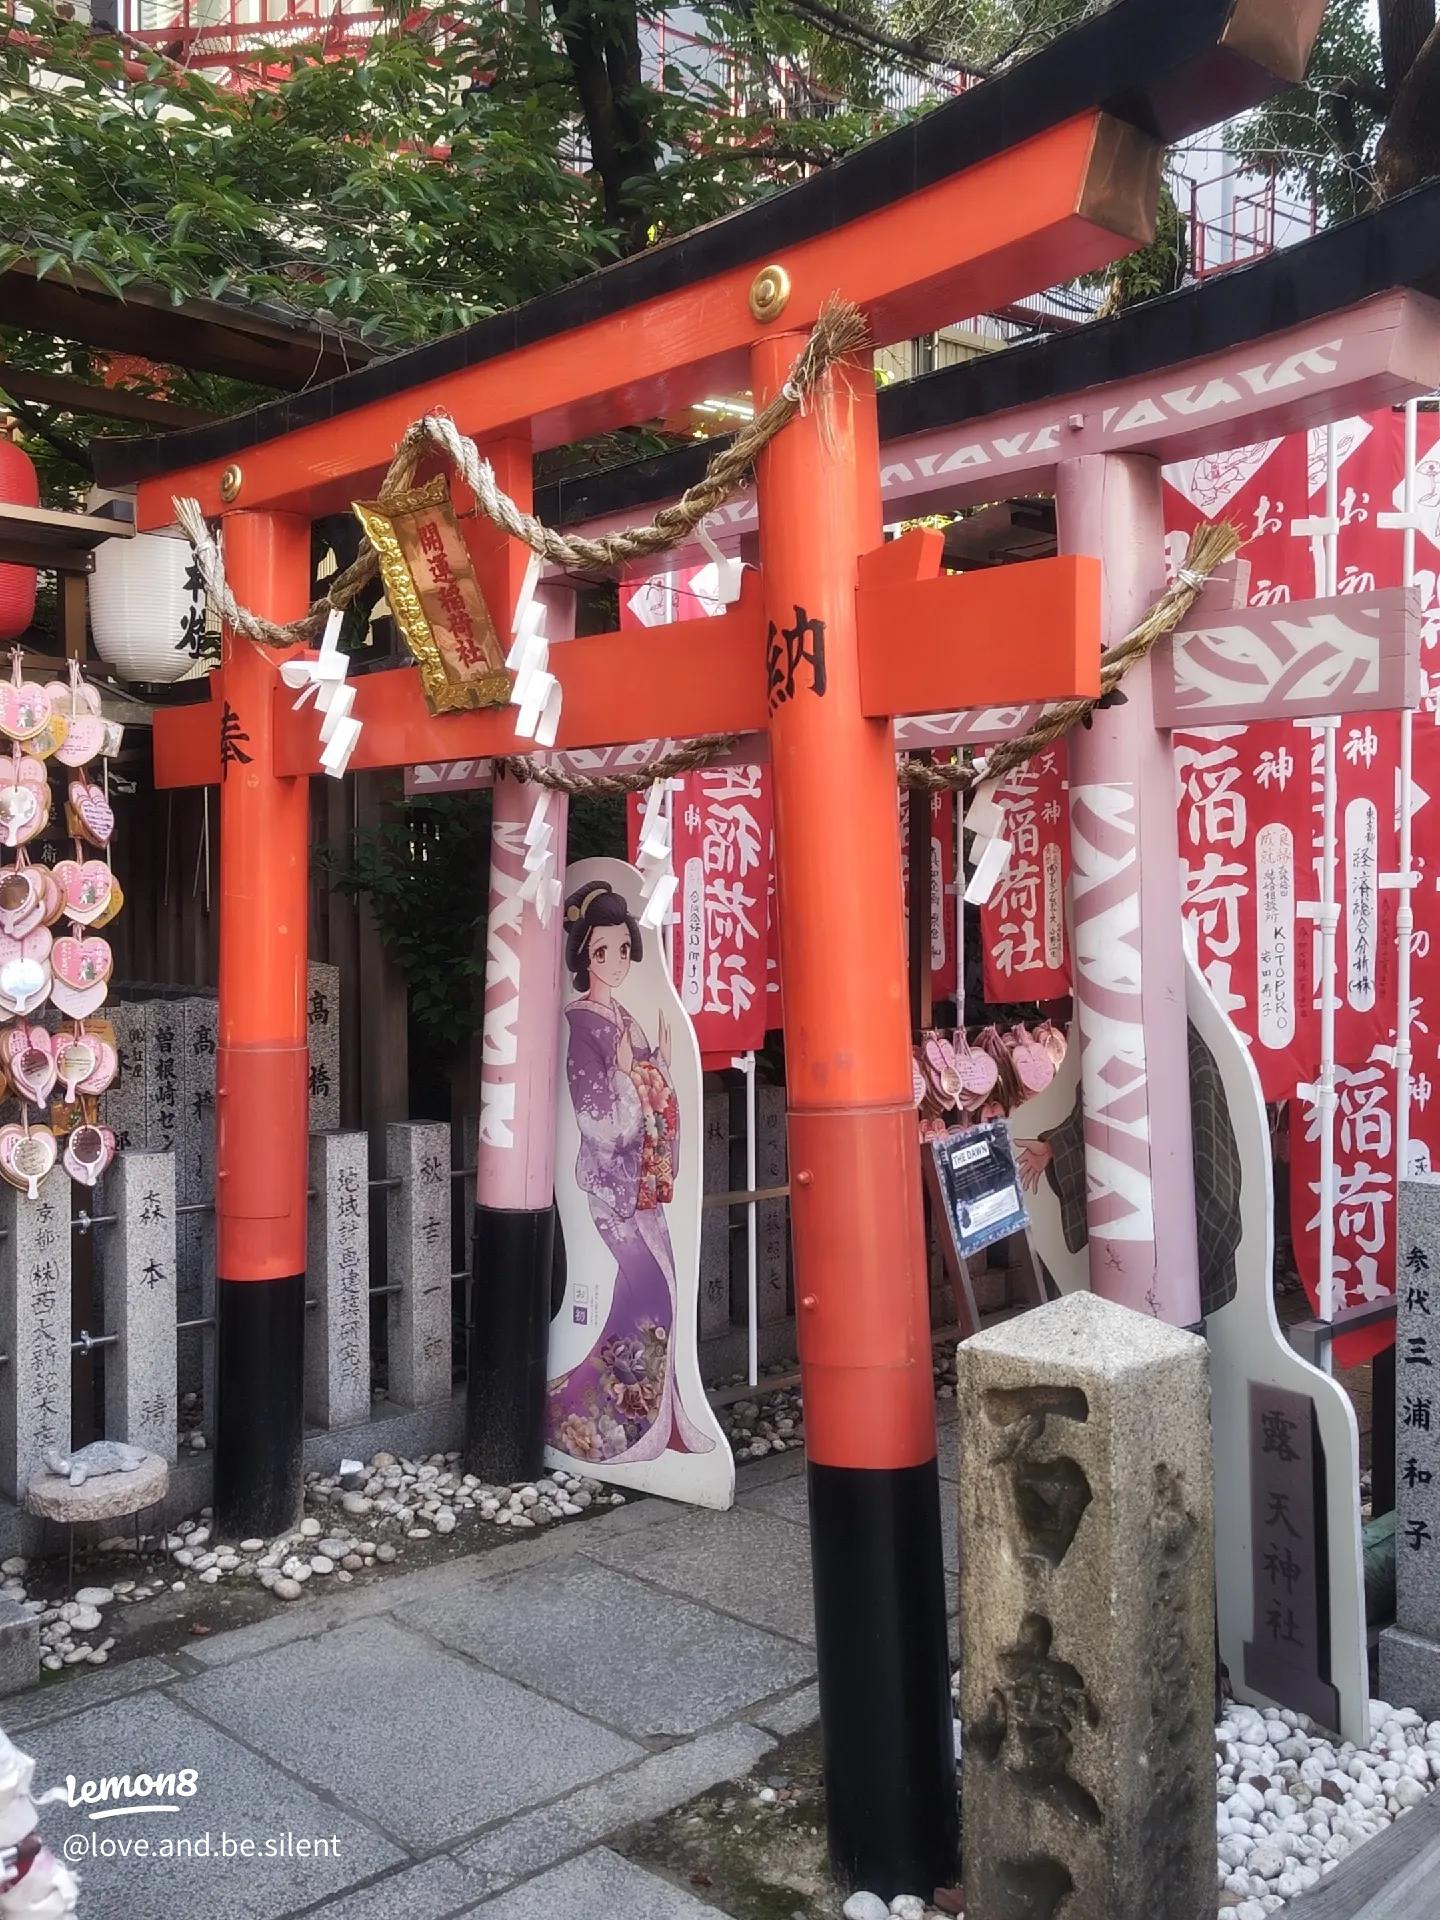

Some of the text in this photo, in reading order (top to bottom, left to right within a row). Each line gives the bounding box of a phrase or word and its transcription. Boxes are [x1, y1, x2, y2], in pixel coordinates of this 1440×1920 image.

[767, 604, 827, 718] 納
[221, 701, 254, 781] 奉
[1261, 1409, 1302, 1648] 露天神社
